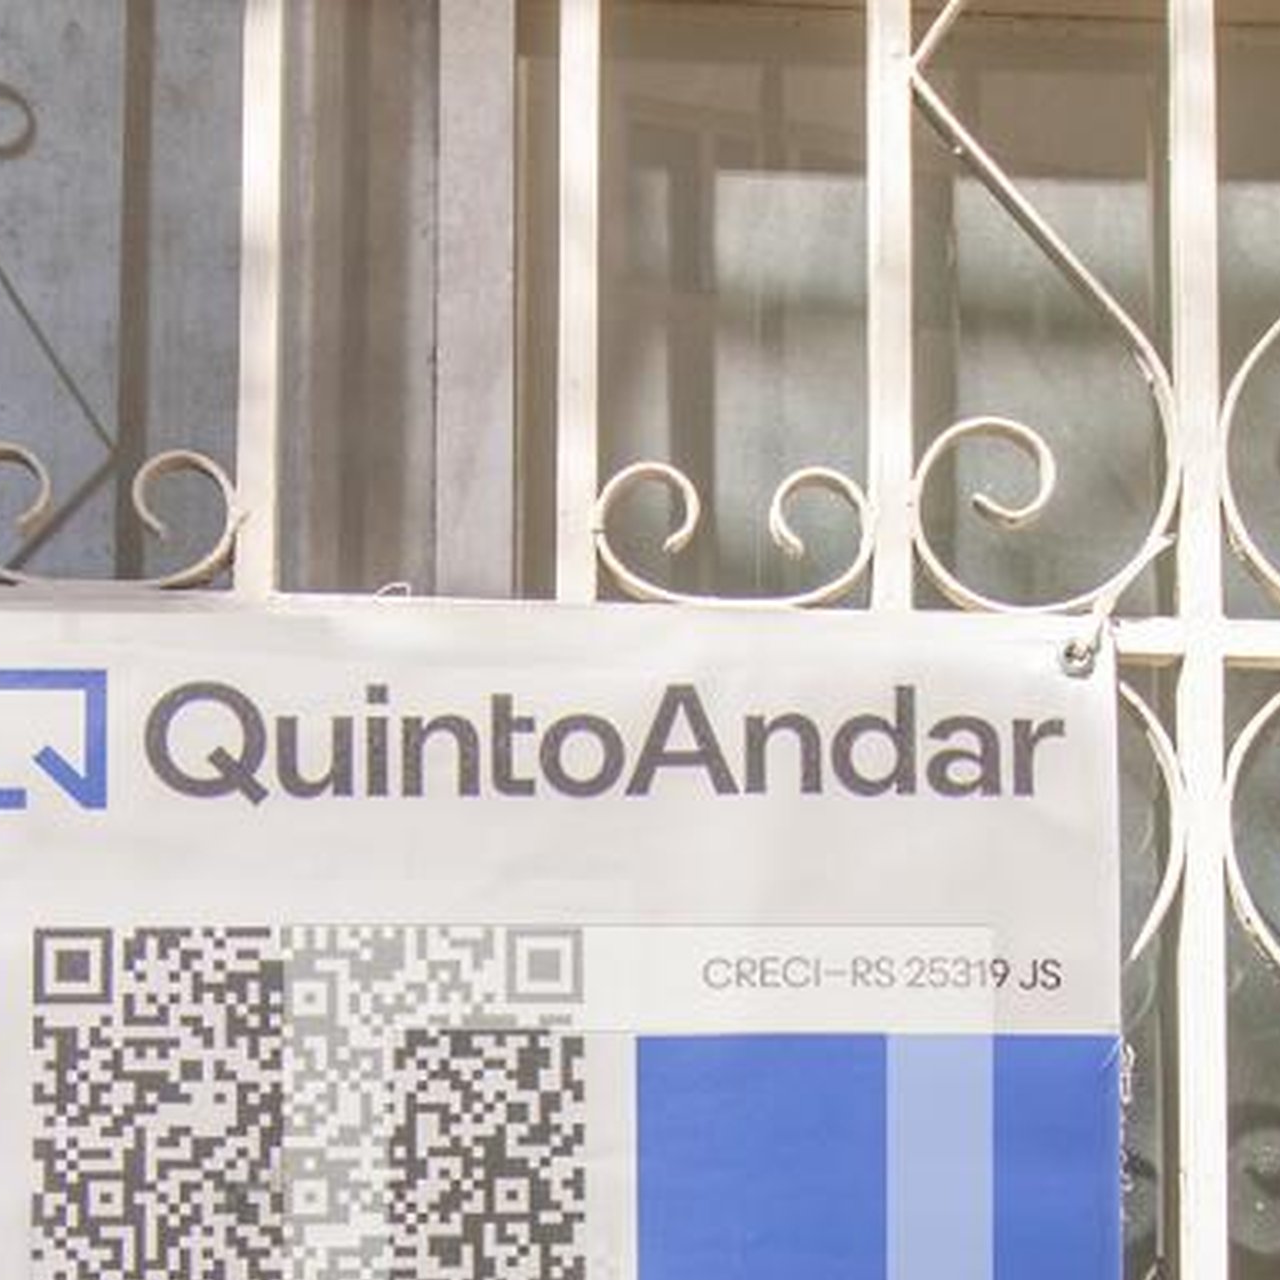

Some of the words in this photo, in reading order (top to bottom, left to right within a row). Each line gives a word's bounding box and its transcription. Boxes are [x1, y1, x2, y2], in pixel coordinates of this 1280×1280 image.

[144, 682, 1065, 806] QuintoAndar
[905, 955, 1012, 990] 25319
[1018, 957, 1063, 991] JS
